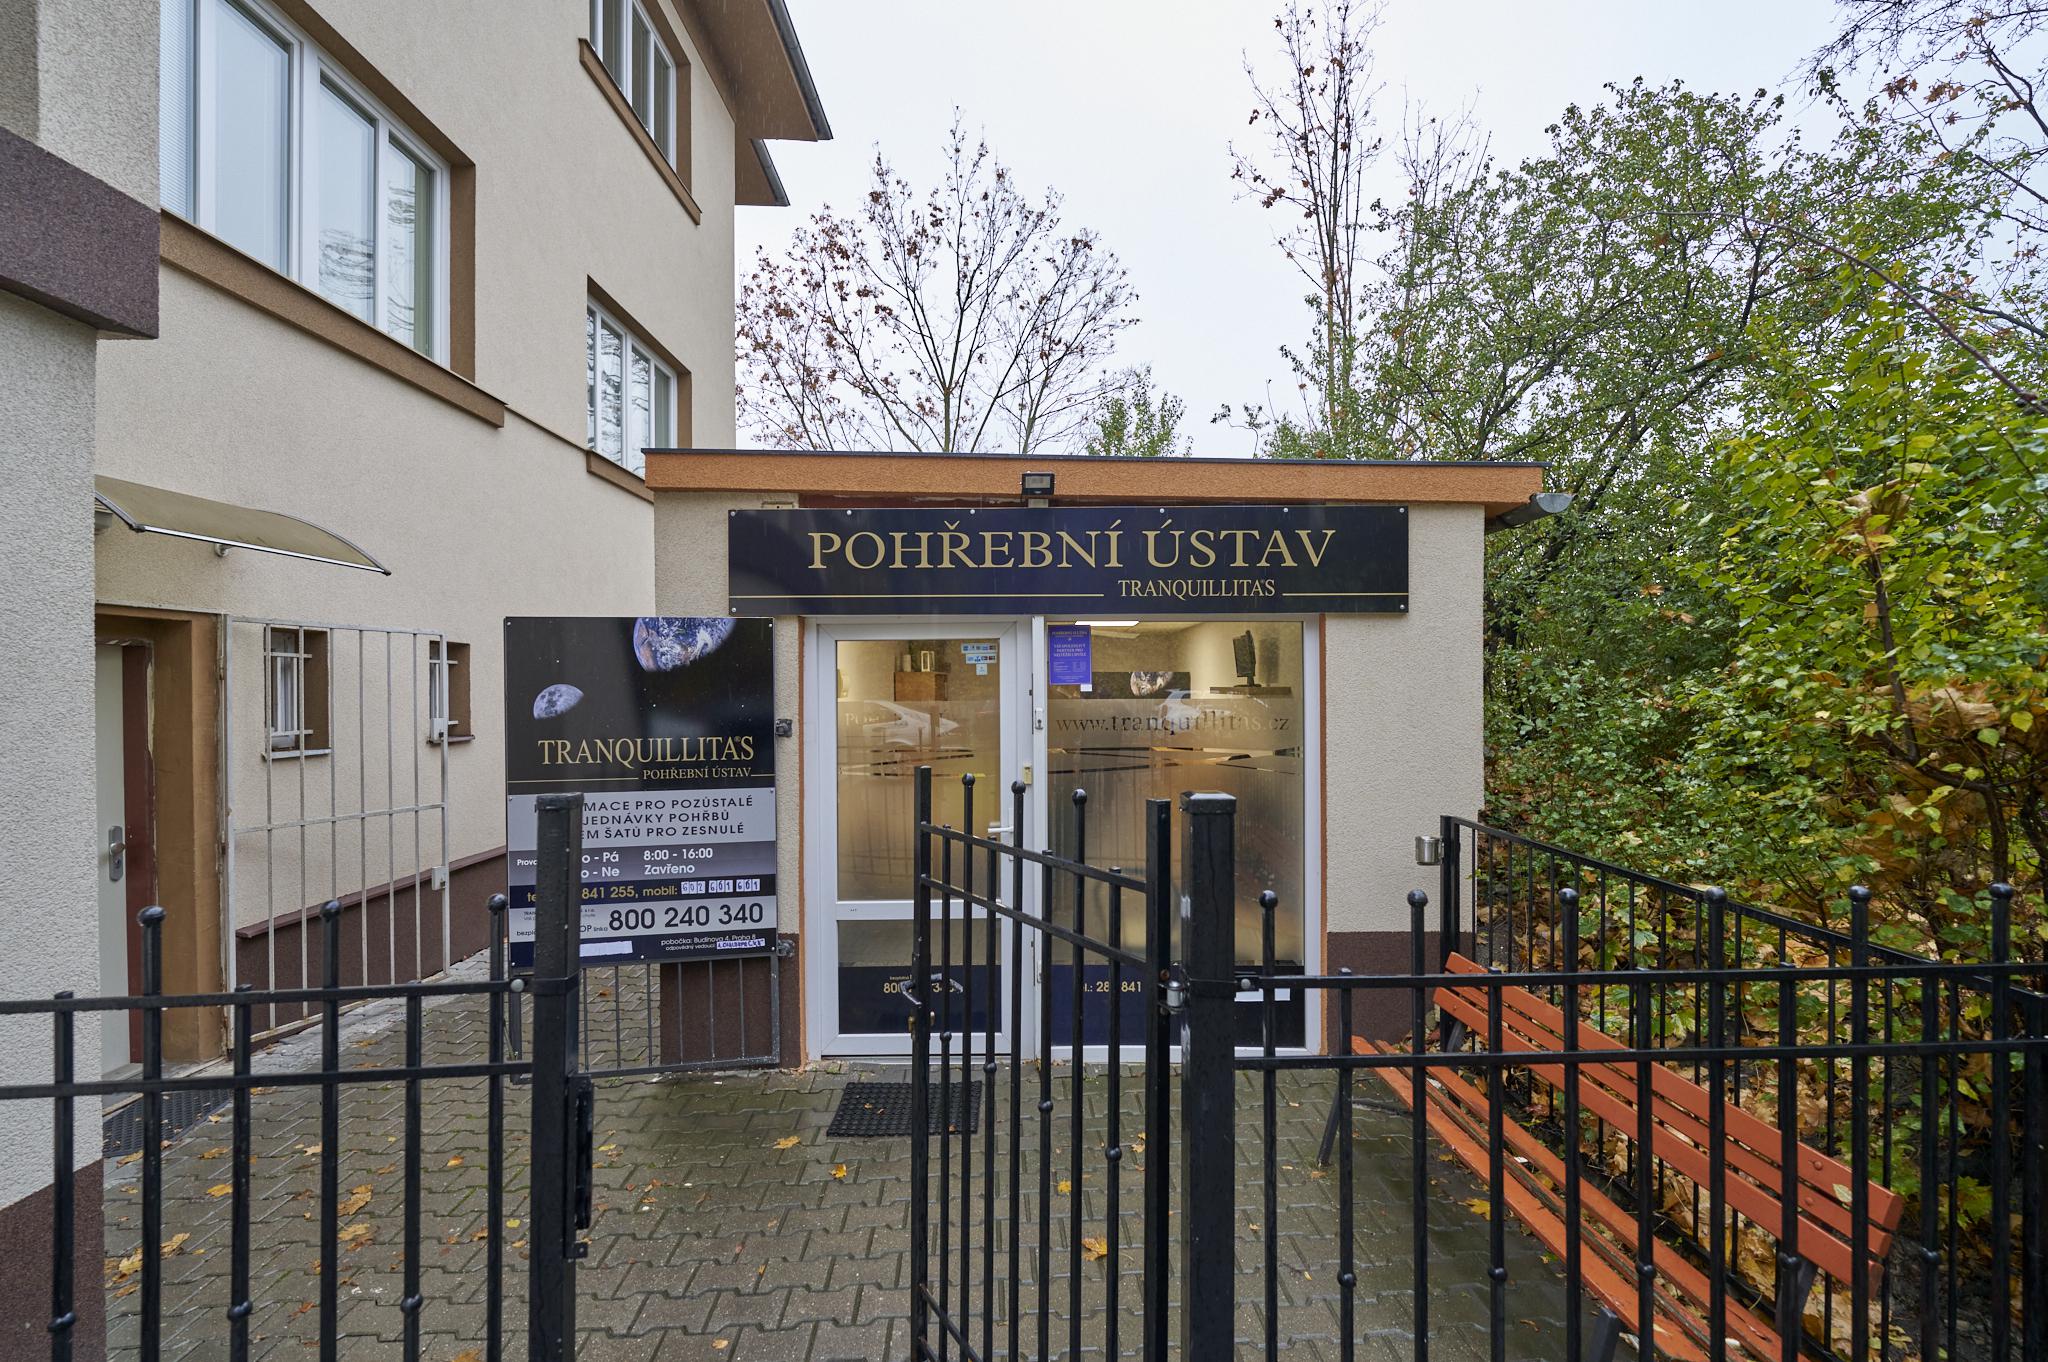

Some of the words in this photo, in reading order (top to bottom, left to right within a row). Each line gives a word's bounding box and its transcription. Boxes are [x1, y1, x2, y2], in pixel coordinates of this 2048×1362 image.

[808, 519, 1124, 569] POHŘEBNÍ
[1142, 518, 1336, 568] ÚSTAV
[1118, 579, 1275, 600] TRANQUILLITAS
[538, 735, 754, 769] TRANQUILLITAS
[643, 767, 709, 780] POHŘEBNÍ
[712, 765, 751, 778] ÚSTAV
[636, 800, 666, 810] PRO
[672, 795, 753, 809] POZŮSTALÉ
[583, 813, 664, 825] JEDNÁVKY
[669, 809, 729, 823] POHŘBŮ
[605, 826, 640, 839] ŠATŮ
[647, 826, 677, 837] PRO
[682, 822, 744, 835] ZESNULÉ
[602, 851, 620, 863] Pá
[643, 850, 669, 861] 8:00
[682, 847, 714, 860] 16:00
[601, 866, 620, 877] Ne
[644, 863, 696, 875] Zavřeno
[581, 887, 605, 899] 841
[610, 886, 639, 899] 255,
[643, 885, 678, 896] mobil:
[608, 908, 656, 931] 800
[664, 905, 710, 928] 240
[718, 902, 763, 925] 340
[661, 938, 692, 946] pobočka:
[1121, 981, 1141, 992] 841
